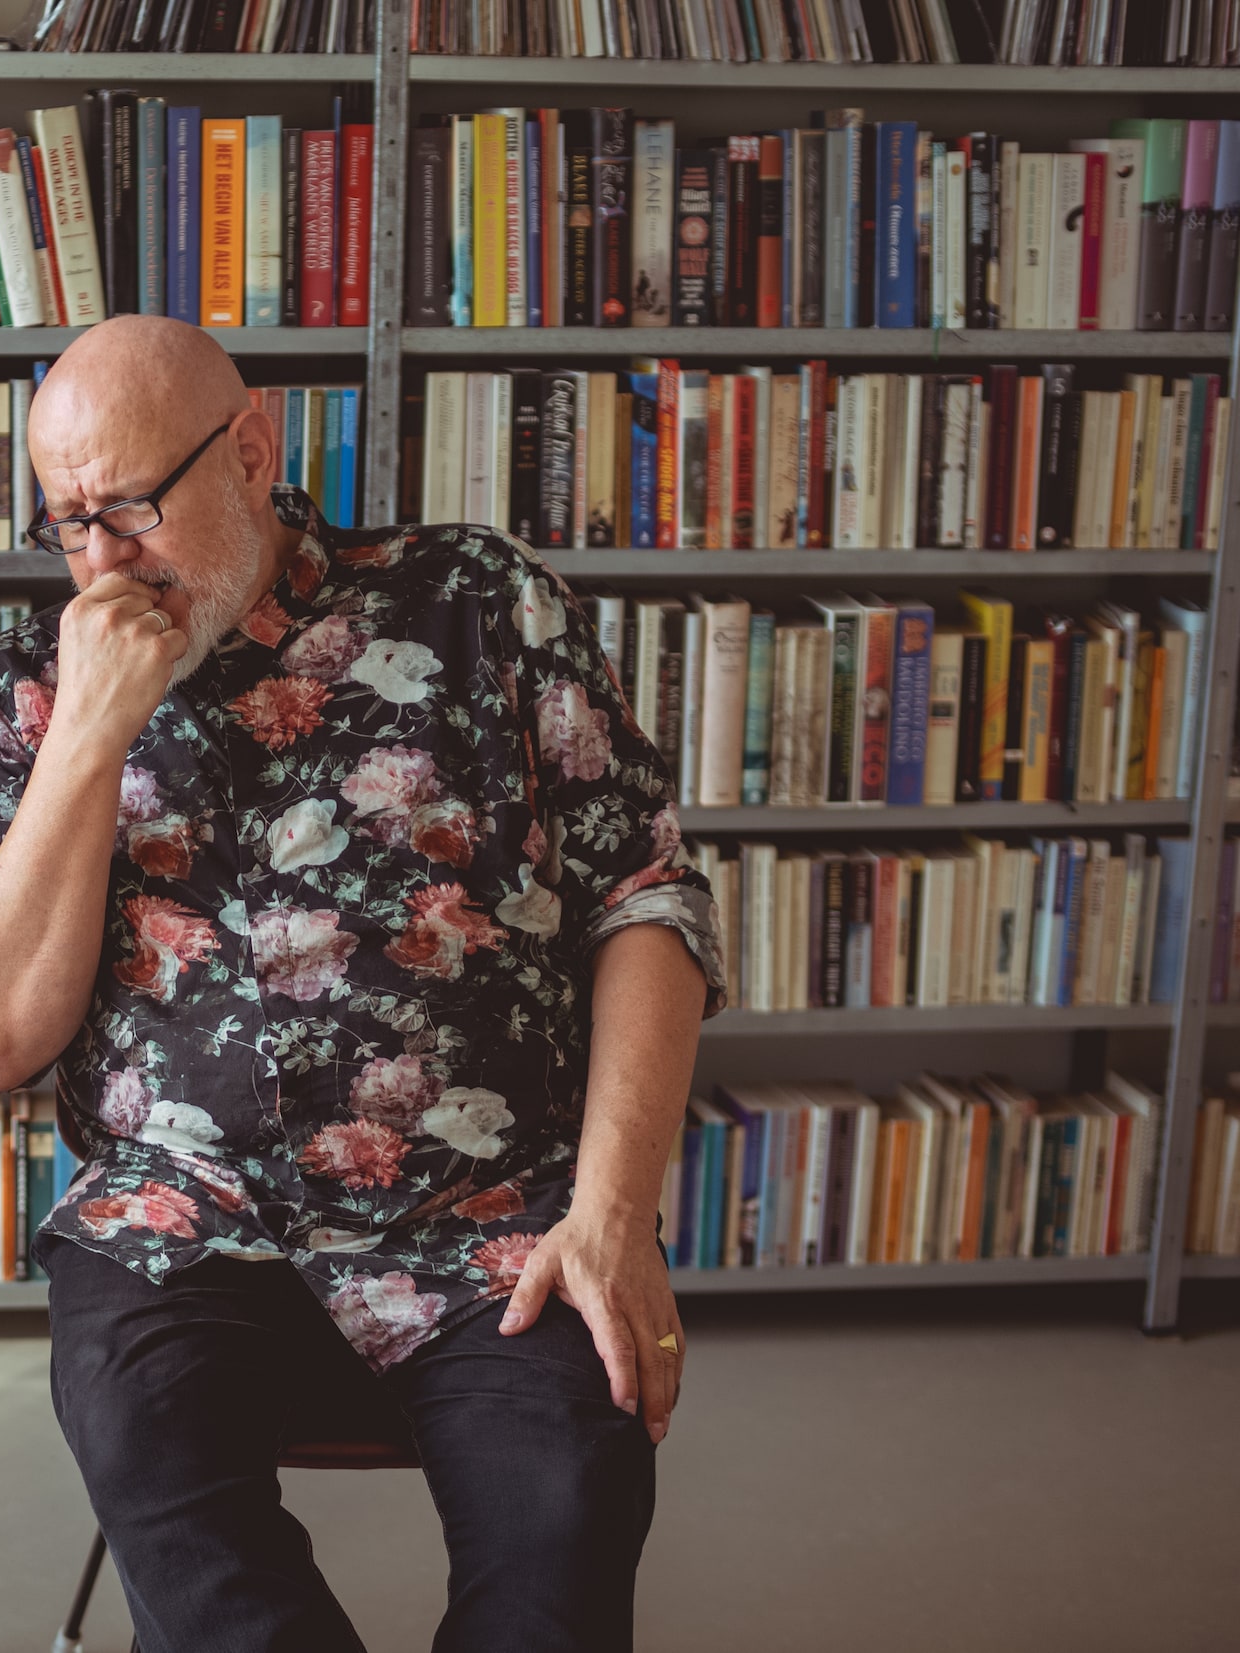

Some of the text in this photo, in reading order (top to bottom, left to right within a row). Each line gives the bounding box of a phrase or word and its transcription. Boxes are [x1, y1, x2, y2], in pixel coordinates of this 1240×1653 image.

[507, 117, 519, 152] ROTTEN
[48, 148, 69, 226] MIDDLE AGES
[62, 135, 86, 223] EUROPE IN THE
[319, 140, 333, 269] FRITS VAN OOSTROM
[424, 164, 433, 219] EVERYTHING
[508, 174, 519, 198] IRISH
[573, 155, 586, 255] BLAKE PETER
[645, 134, 663, 217] LEHANE
[213, 143, 232, 290] HET BEGIN VAN ALLES
[305, 220, 319, 269] WERELD
[346, 196, 361, 285] Julia's verdwijning
[508, 217, 519, 251] BLACKS
[424, 246, 433, 297] DISSOLVING
[508, 270, 519, 294] DOGS
[895, 656, 913, 762] BAUDOLINO
[913, 656, 928, 761] UMBERTO ECO
